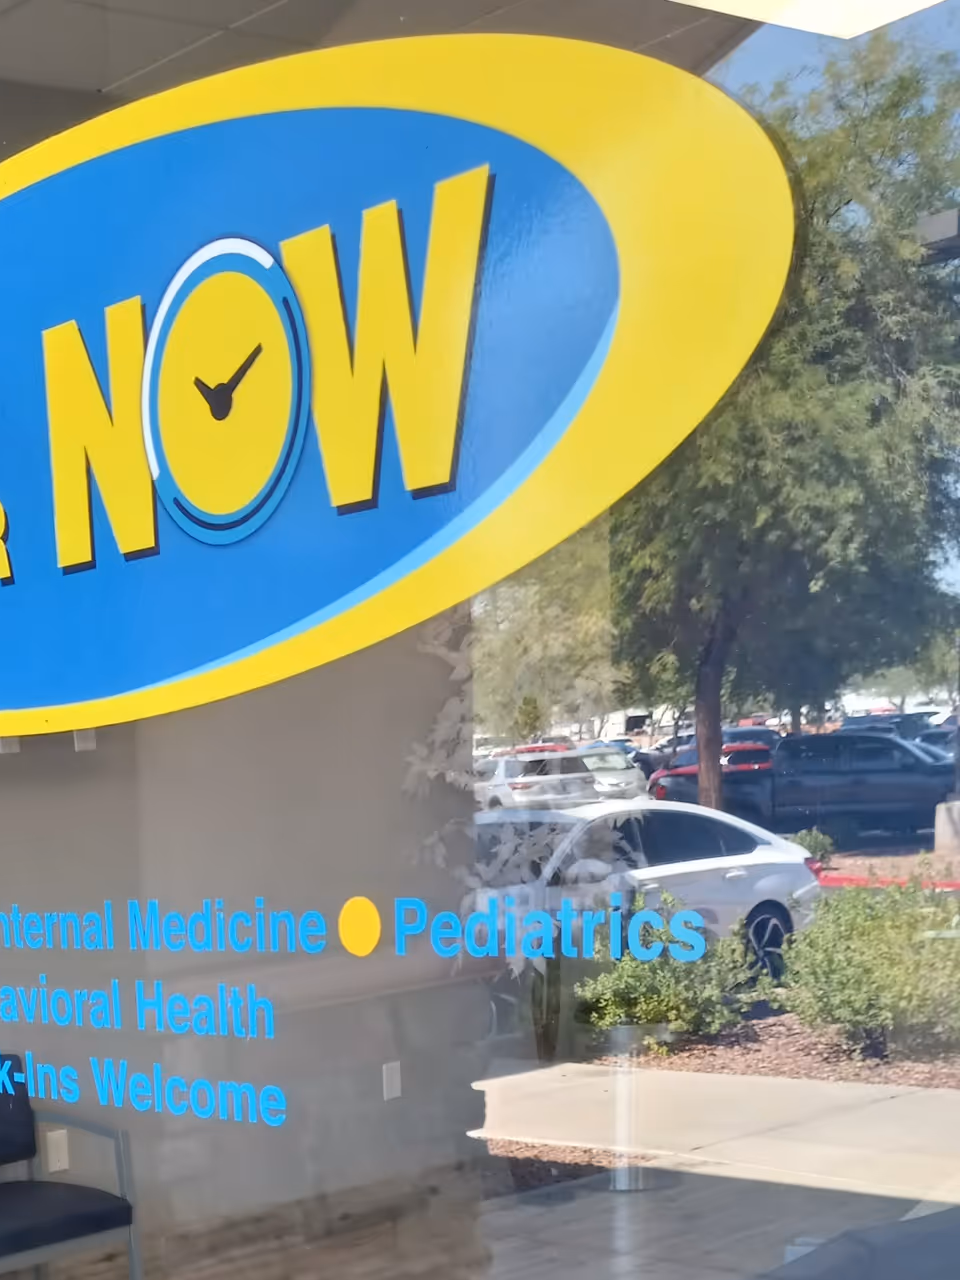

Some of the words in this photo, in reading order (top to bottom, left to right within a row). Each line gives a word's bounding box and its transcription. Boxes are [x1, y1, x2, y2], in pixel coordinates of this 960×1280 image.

[43, 164, 493, 569] NOW
[127, 896, 328, 954] Medicine
[394, 891, 707, 962] Pediatrics
[135, 980, 275, 1039] Health
[90, 1056, 288, 1127] Welcome
